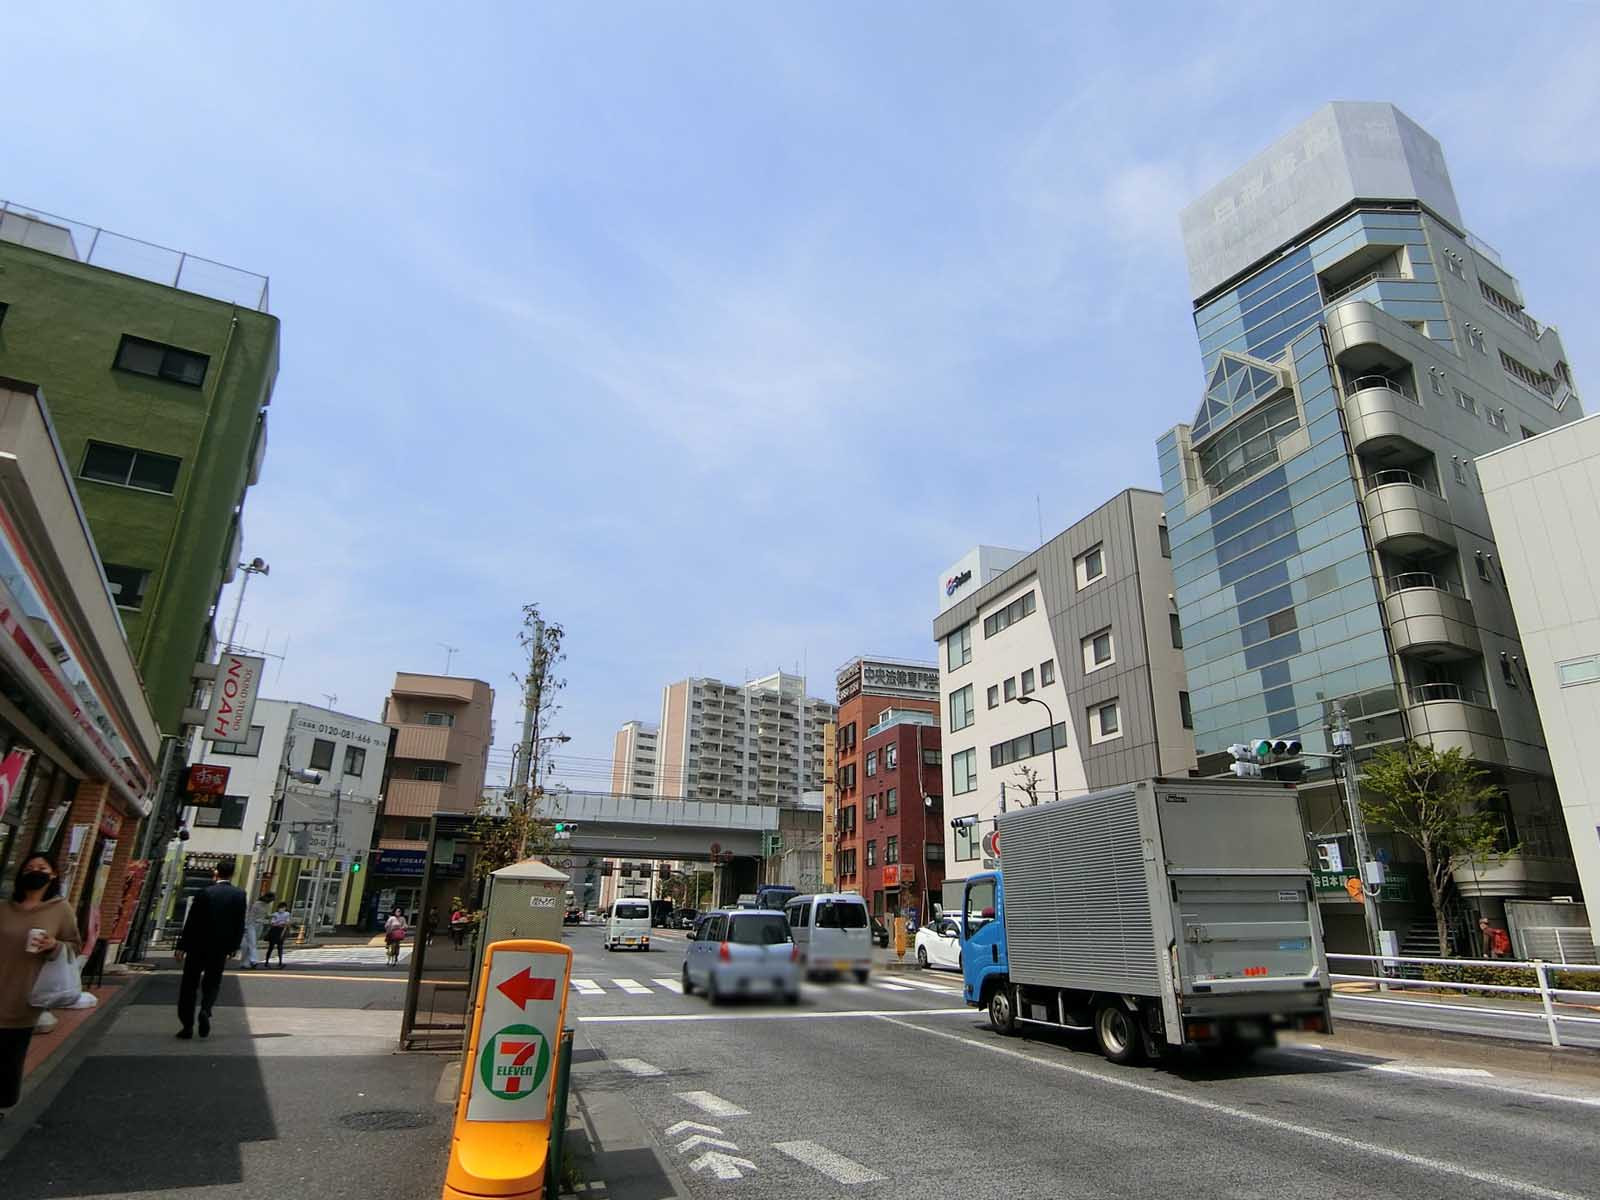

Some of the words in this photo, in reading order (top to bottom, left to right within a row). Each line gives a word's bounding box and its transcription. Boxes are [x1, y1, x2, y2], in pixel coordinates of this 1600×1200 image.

[214, 658, 243, 737] NOAH
[241, 669, 254, 698] SOUND
[496, 1067, 532, 1077] ELEVEN
[501, 1042, 536, 1092] 7
